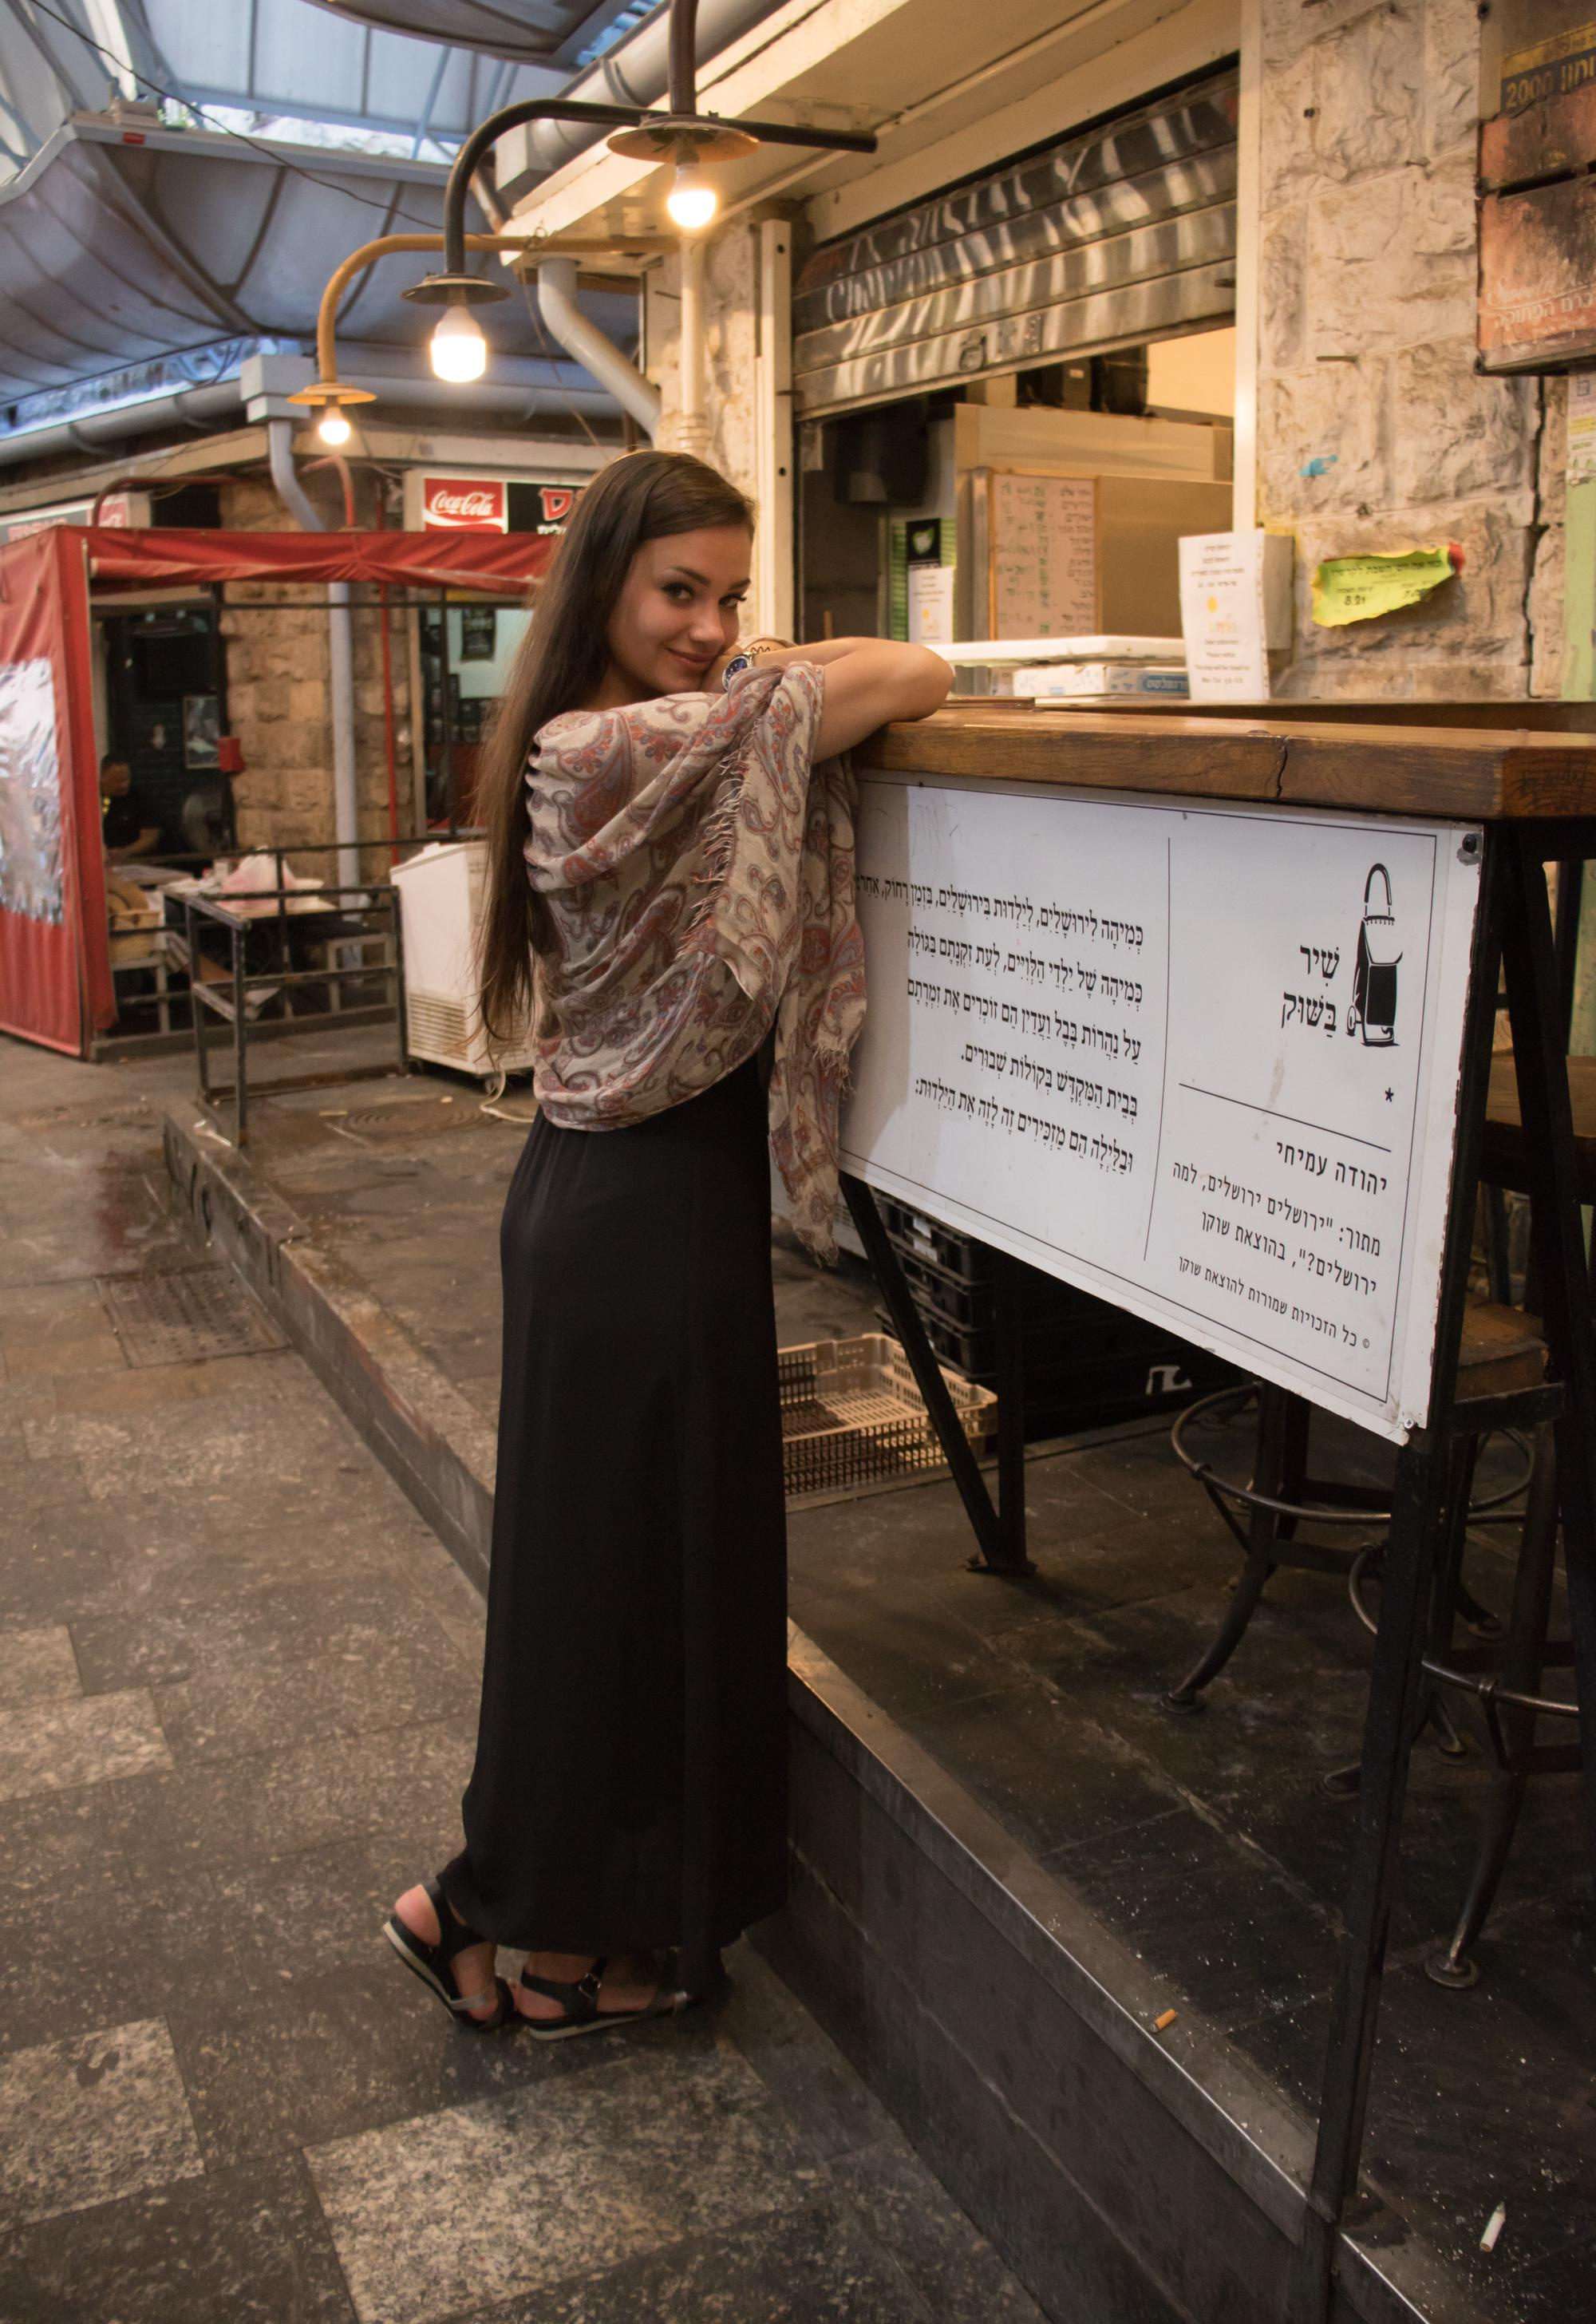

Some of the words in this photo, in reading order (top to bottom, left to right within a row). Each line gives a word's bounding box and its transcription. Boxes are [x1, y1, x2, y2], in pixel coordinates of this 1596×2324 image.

[1172, 1161, 1198, 1185] למה
[1277, 1141, 1328, 1176] עמיחי
[1201, 1173, 1262, 1207] ירושלים,
[1335, 1160, 1388, 1196] יהודה
[1201, 1211, 1231, 1236] שוקן
[1235, 1223, 1287, 1262] בהוצאת
[1339, 1226, 1381, 1257] מתוך:
[1179, 1255, 1202, 1277] שוקן
[1204, 1266, 1245, 1296] להוצאת
[1247, 1286, 1288, 1315] שמורות
[1291, 1305, 1337, 1338] הזכויות
[1342, 1324, 1357, 1348] כל
